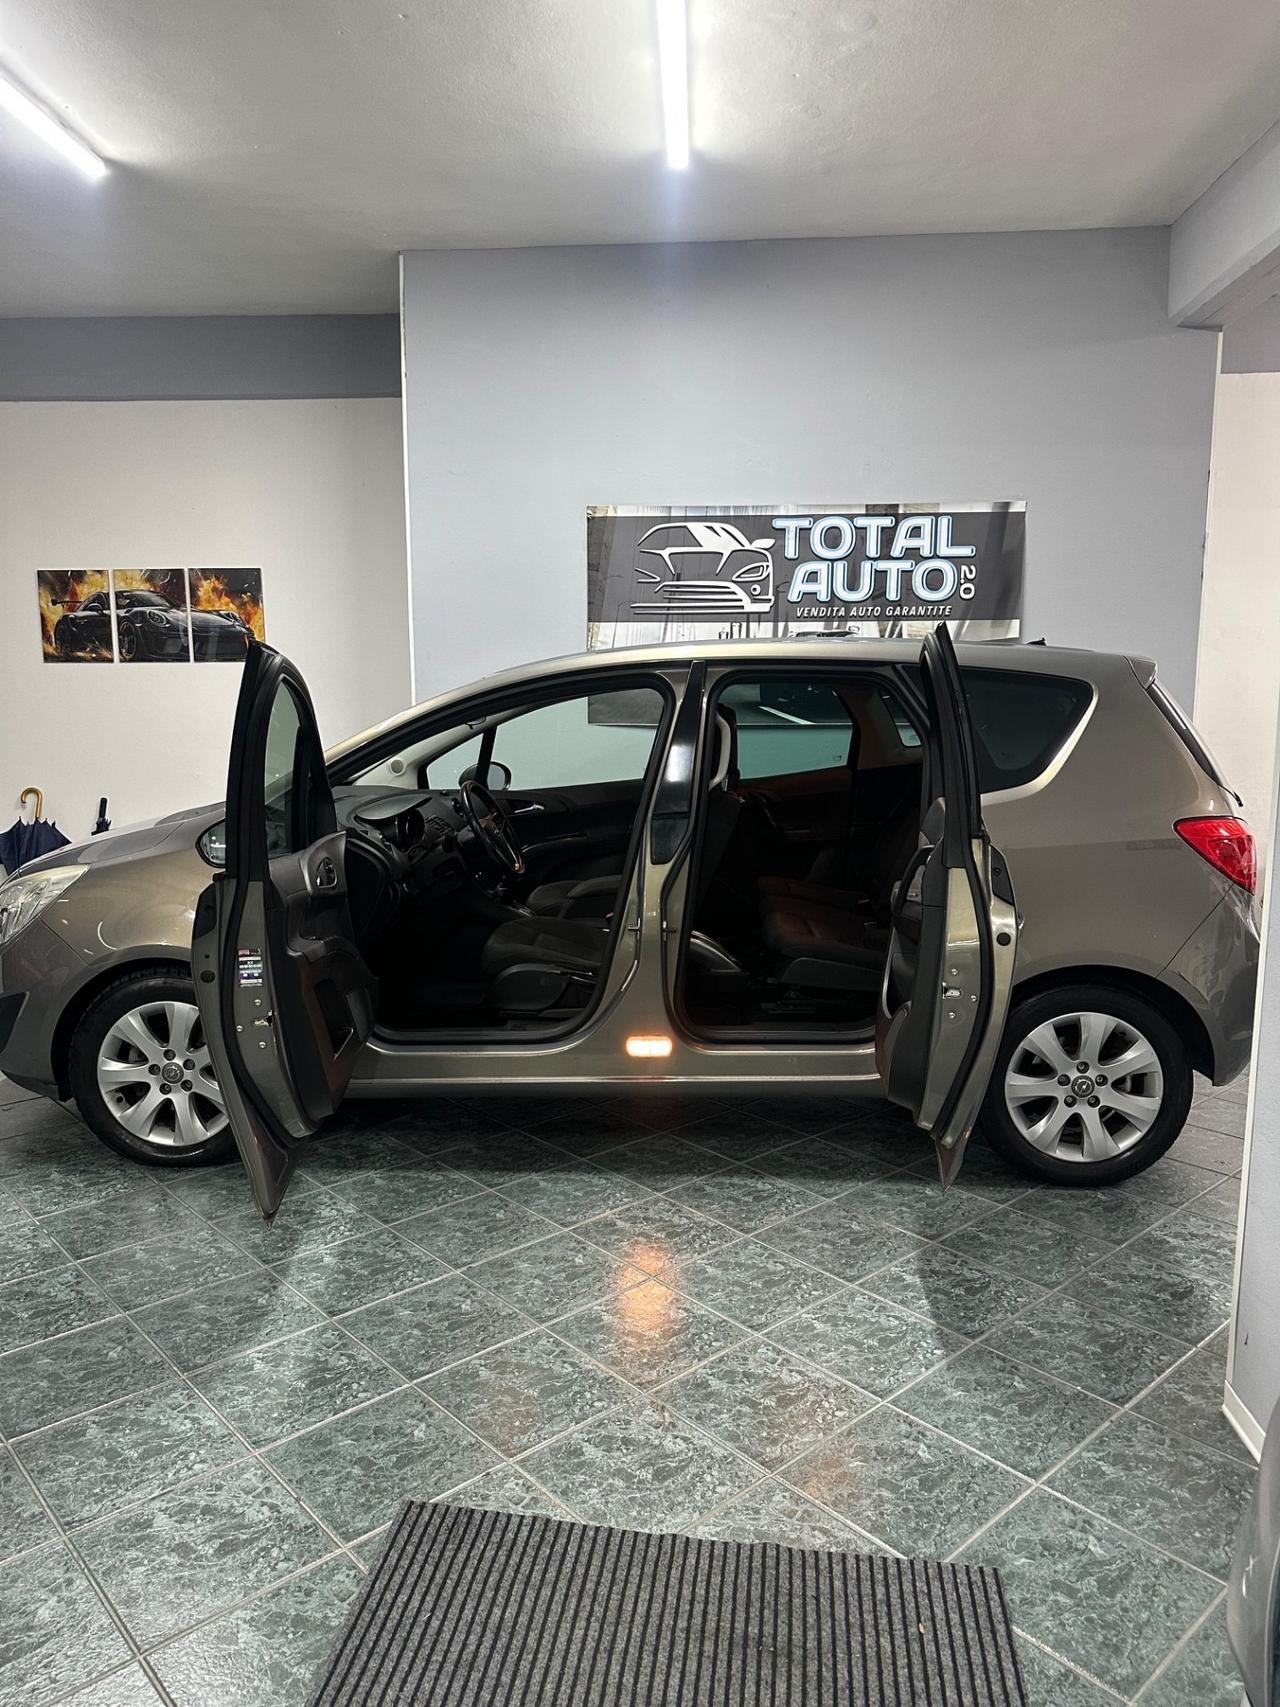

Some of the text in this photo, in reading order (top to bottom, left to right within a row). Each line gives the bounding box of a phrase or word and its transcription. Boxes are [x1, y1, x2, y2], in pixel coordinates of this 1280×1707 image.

[772, 516, 976, 559] TOTAL
[787, 558, 958, 602] AUTO
[959, 564, 977, 600] 2.0
[796, 605, 953, 618] VENDITA AUTO GARANTITE
